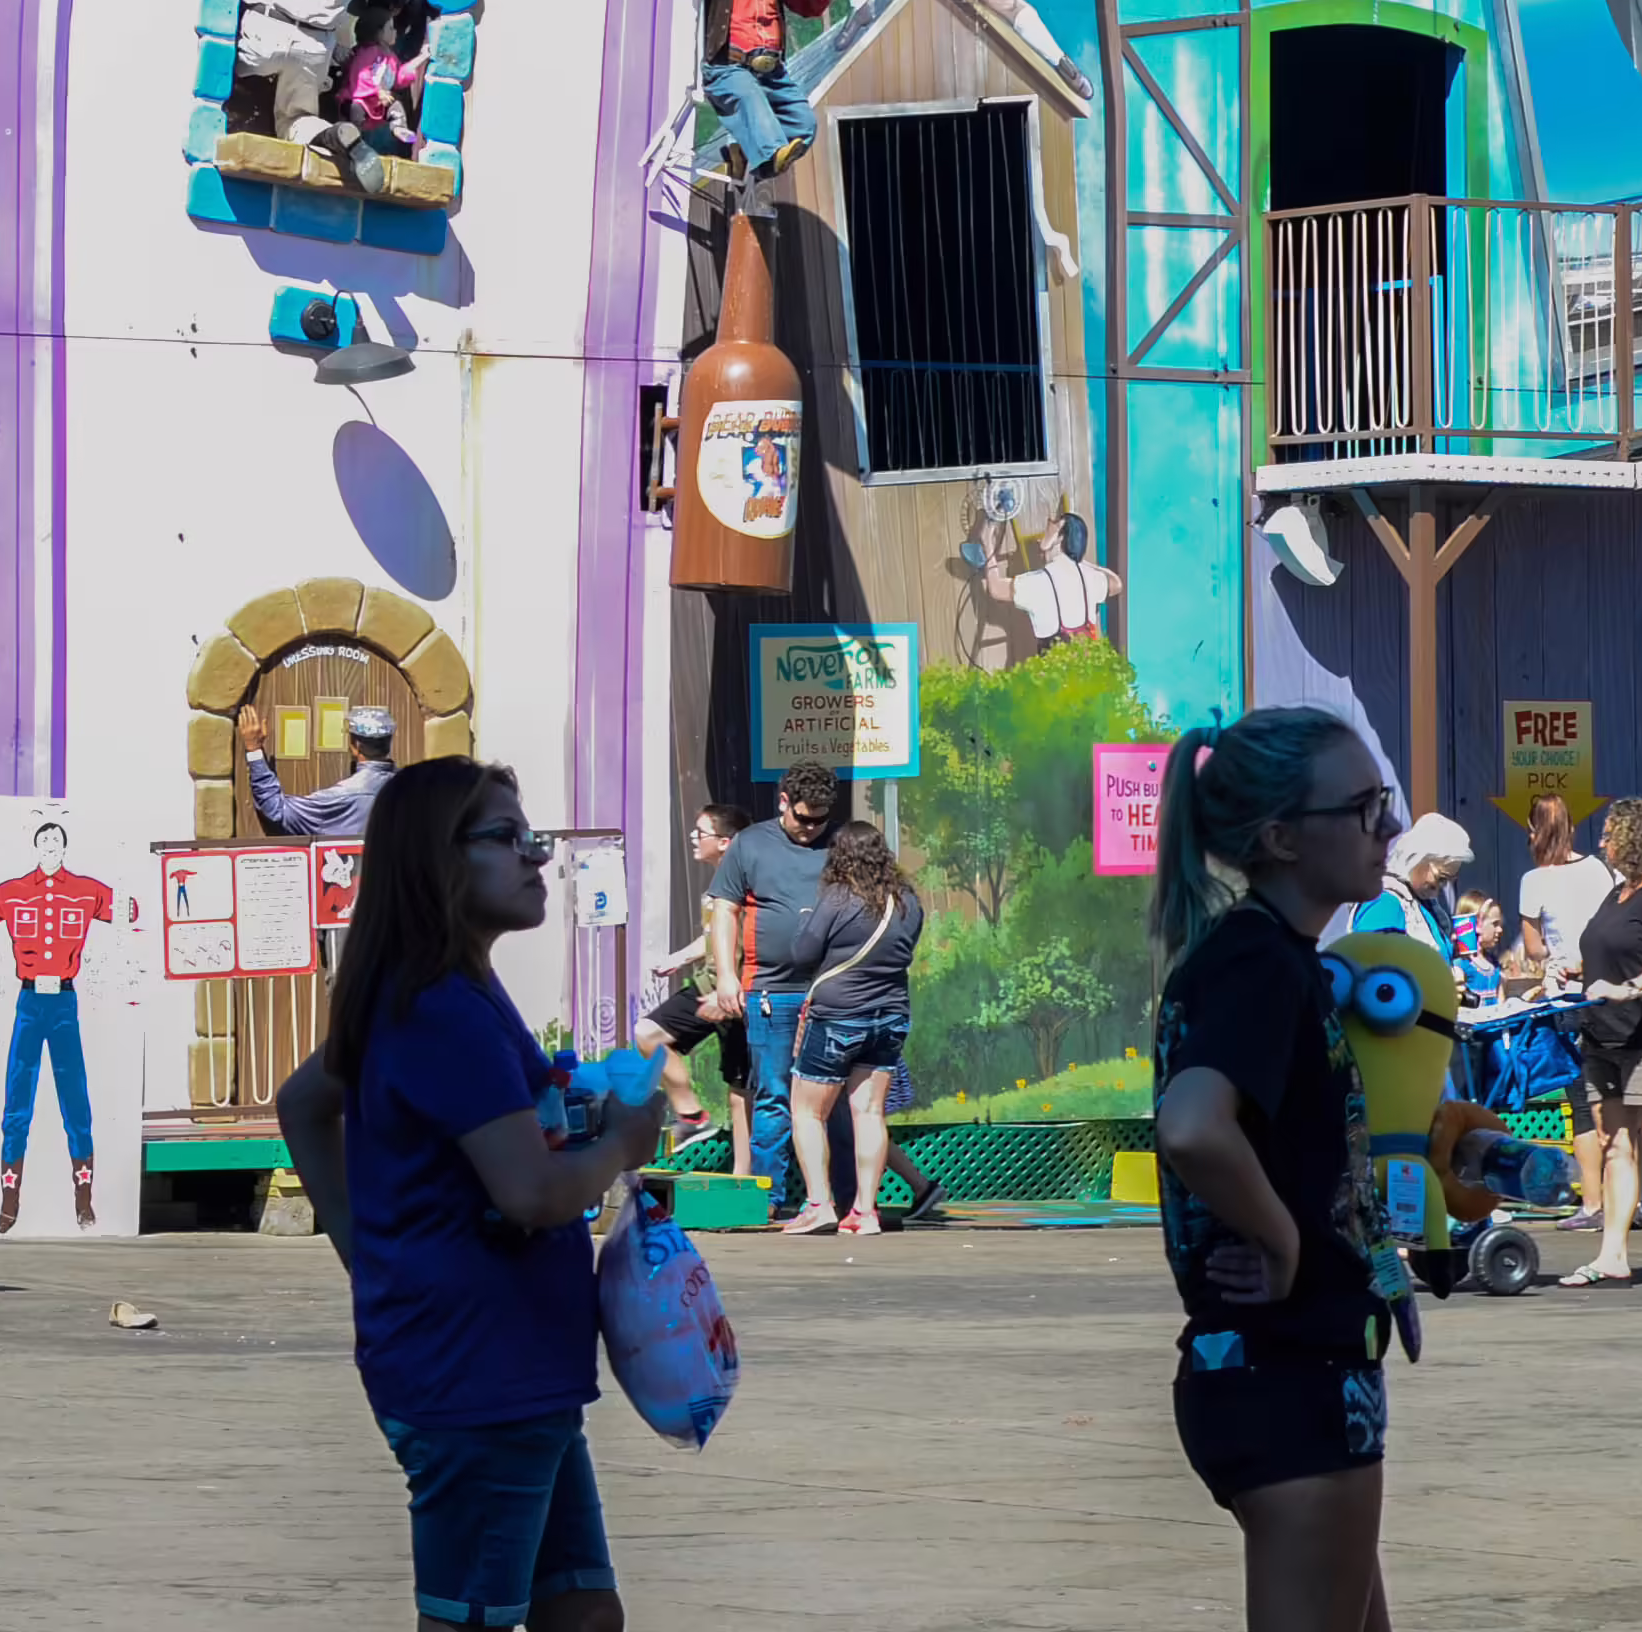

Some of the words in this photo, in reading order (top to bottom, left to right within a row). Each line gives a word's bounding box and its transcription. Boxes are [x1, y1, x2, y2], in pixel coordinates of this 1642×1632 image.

[338, 645, 370, 665] ROOM
[846, 667, 897, 690] FARMS
[791, 695, 875, 710] GROWERS
[783, 717, 881, 733] ARTIFICIAL
[1514, 710, 1578, 747] FREE
[777, 738, 819, 755] Fruits
[829, 737, 890, 758] Vegetables
[1106, 773, 1141, 798] PUSH
[1527, 772, 1569, 789] PICK
[1110, 808, 1124, 822] TO
[1128, 803, 1158, 827] HE
[1130, 834, 1158, 851] TIM
